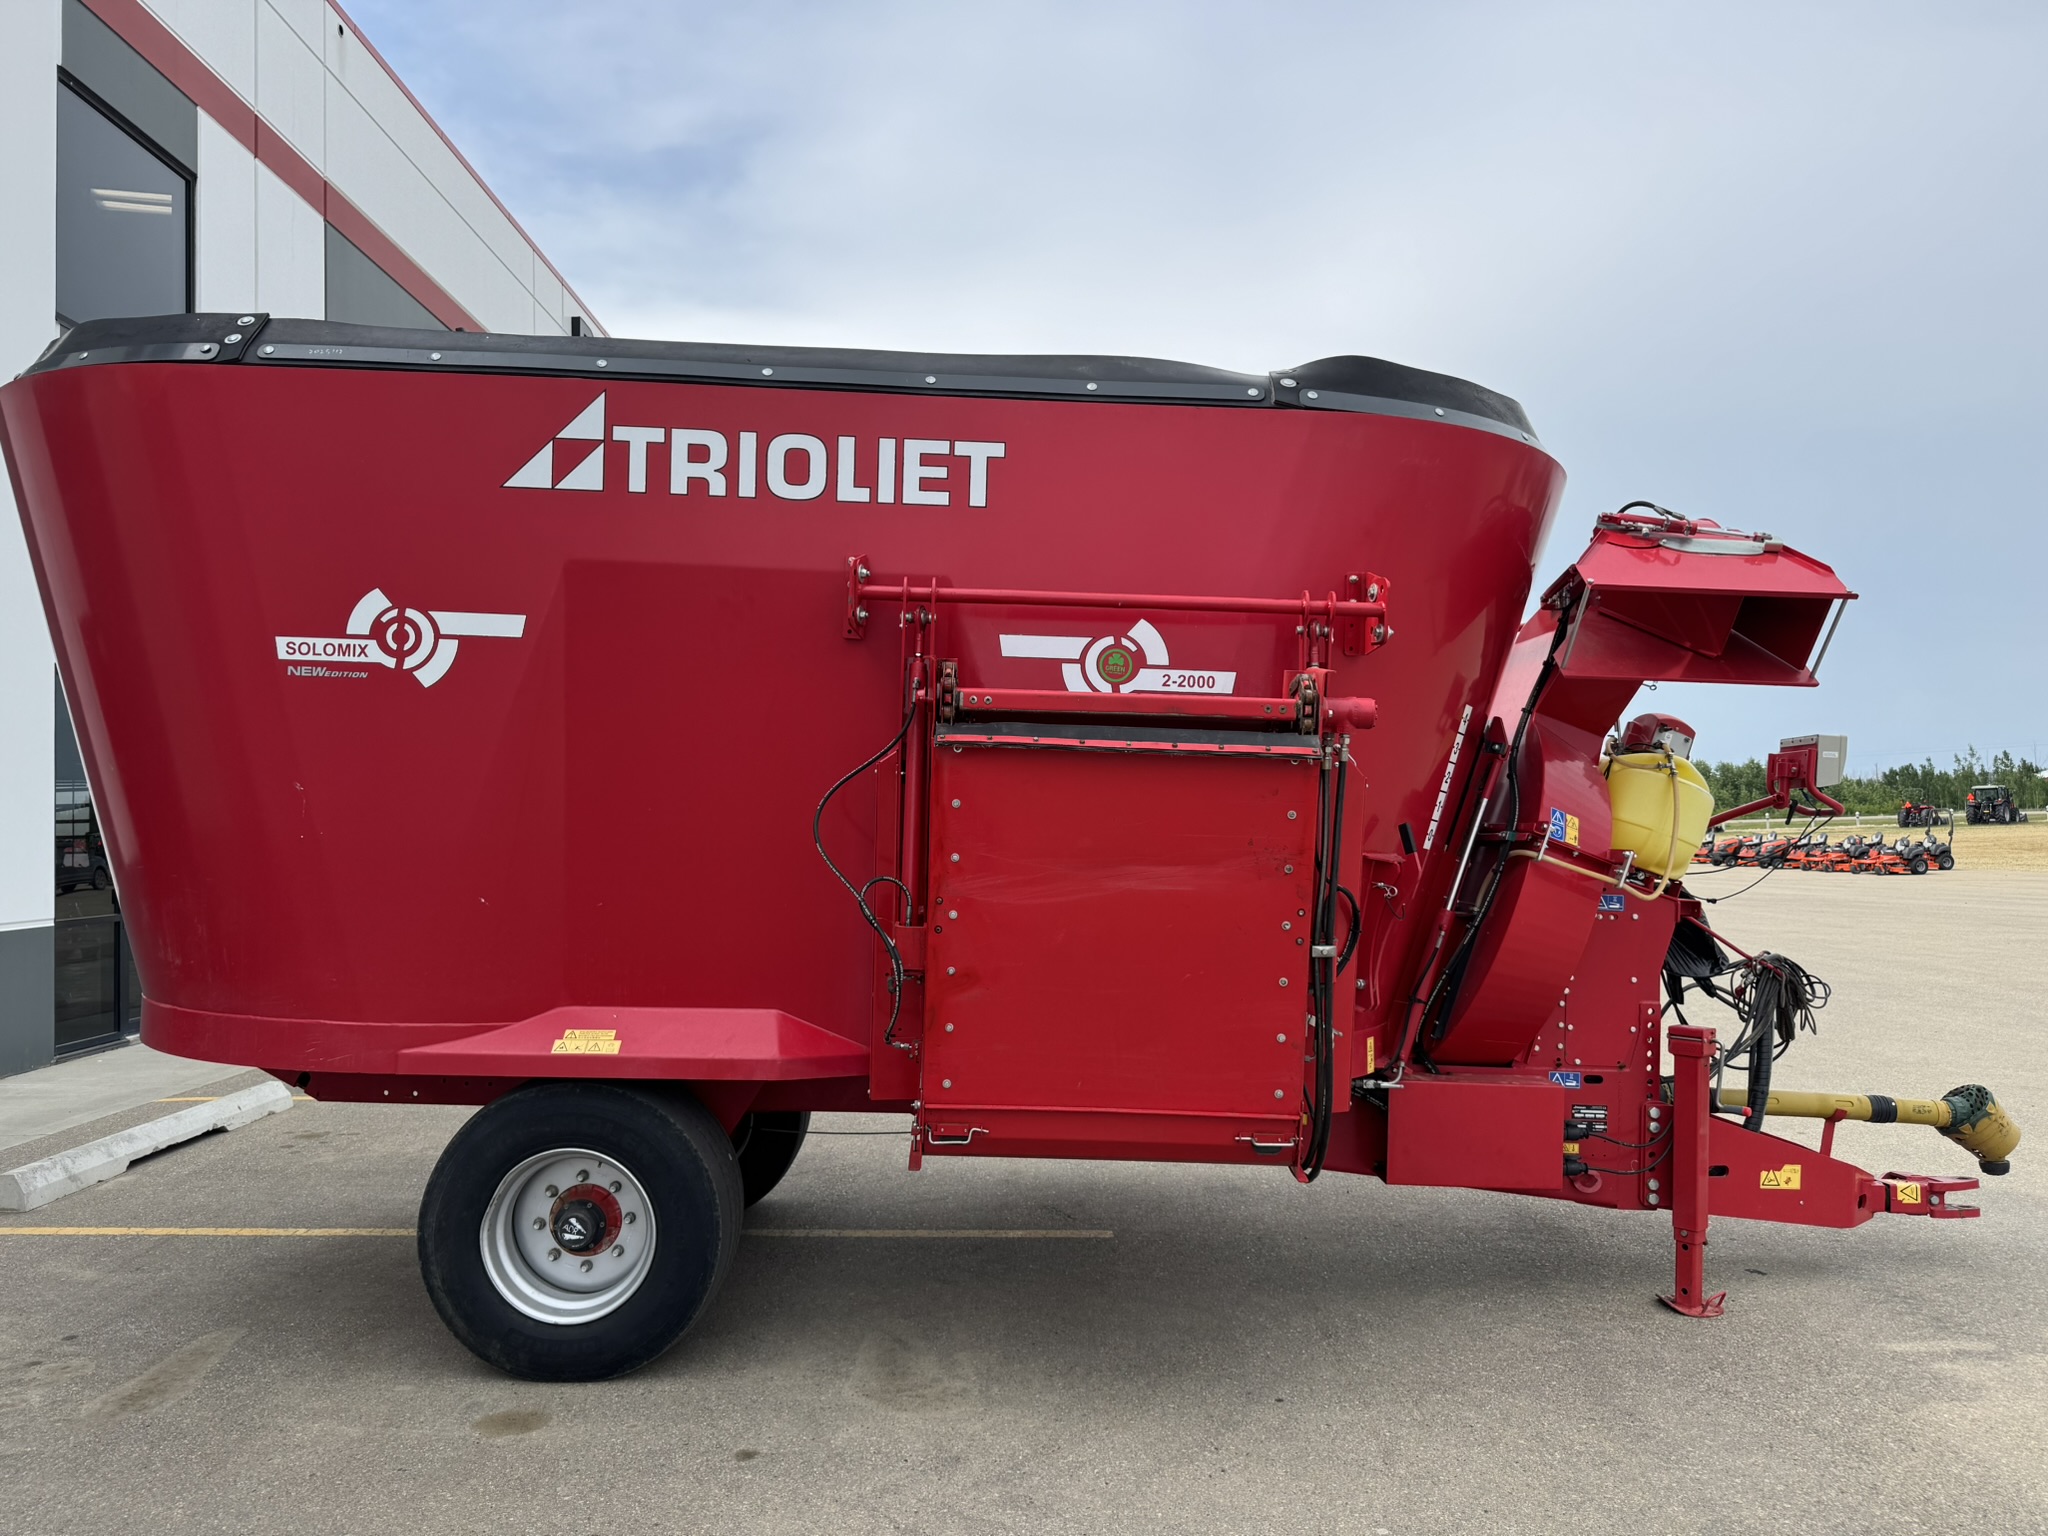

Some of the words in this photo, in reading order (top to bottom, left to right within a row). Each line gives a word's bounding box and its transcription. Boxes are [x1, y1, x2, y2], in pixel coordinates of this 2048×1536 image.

[612, 425, 1006, 508] TRIOLIET
[285, 641, 369, 658] SOLOMIX
[1161, 673, 1216, 689] 2-2000
